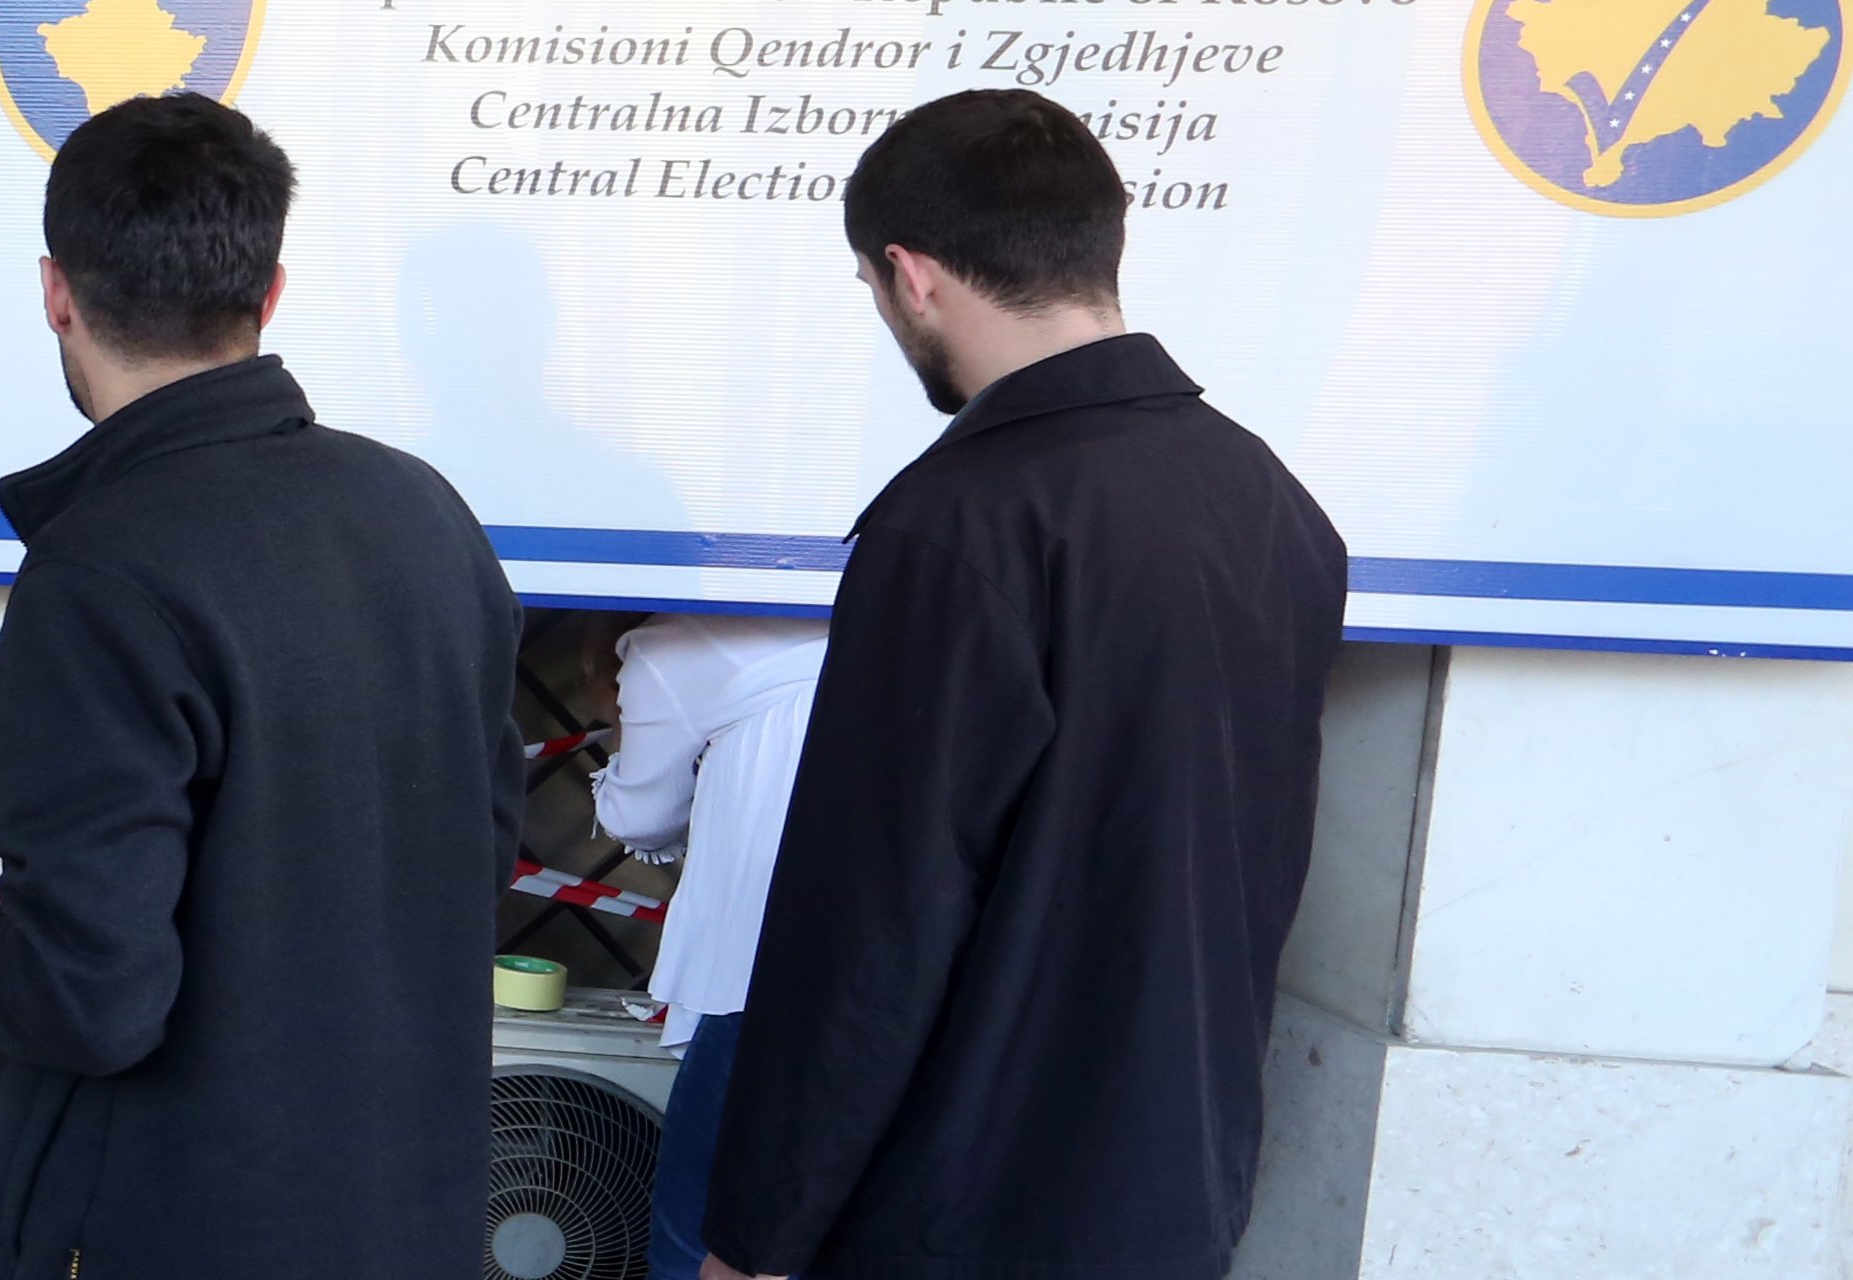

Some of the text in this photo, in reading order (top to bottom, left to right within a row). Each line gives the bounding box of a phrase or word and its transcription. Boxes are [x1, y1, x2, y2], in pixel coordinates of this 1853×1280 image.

[421, 23, 1285, 87] Komisioni Qendror i Zgjedhjeve
[469, 90, 1219, 157] Centralna Izbor isija
[450, 155, 641, 198] Central
